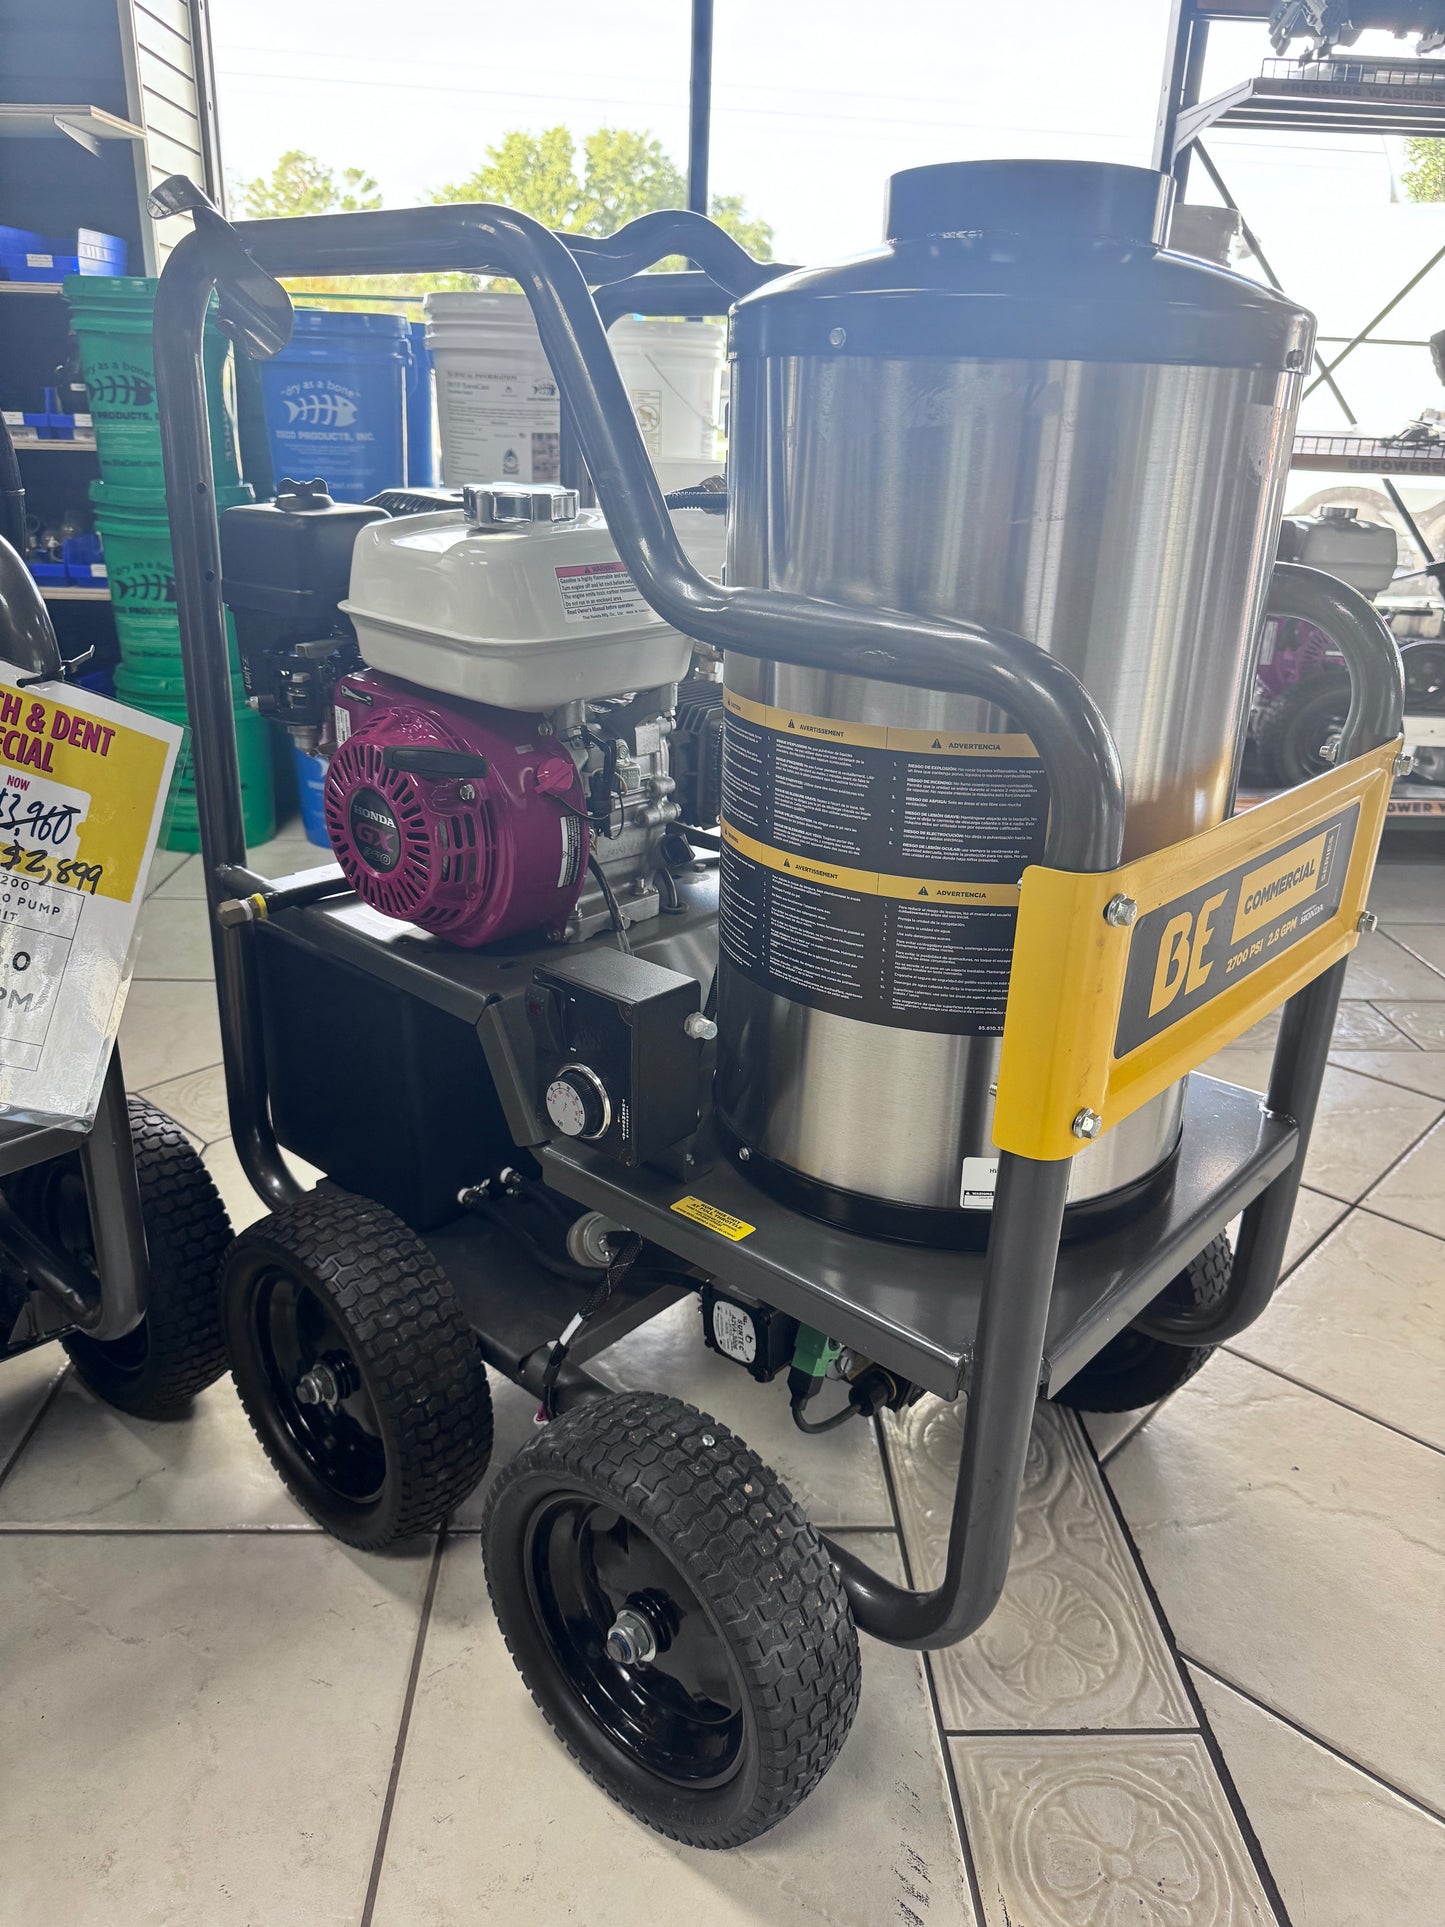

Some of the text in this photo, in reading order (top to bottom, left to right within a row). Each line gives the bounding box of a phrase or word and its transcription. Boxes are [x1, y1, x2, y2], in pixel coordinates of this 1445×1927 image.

[0, 690, 116, 757] H & DENT
[799, 724, 845, 738] AVERTISSEMENT
[948, 742, 1001, 751] ADVERTENCIA
[7, 775, 31, 791] NOW
[353, 804, 397, 829] HONDA
[1387, 802, 1432, 813] OWER
[356, 822, 394, 853] GX
[0, 839, 104, 896] $2,899
[1321, 835, 1334, 882] SERIES
[795, 864, 839, 879] AVERTISSEMENT
[936, 889, 987, 899] ADVERTENCIA
[1243, 858, 1316, 915] COMMERCIAL
[17, 897, 60, 915] PUMP
[1300, 904, 1324, 925] HONDA
[1148, 888, 1229, 1019] BE
[1226, 916, 1298, 974] 2700 PSI 2.8 GPM
[737, 1318, 745, 1351] SUNTEC
